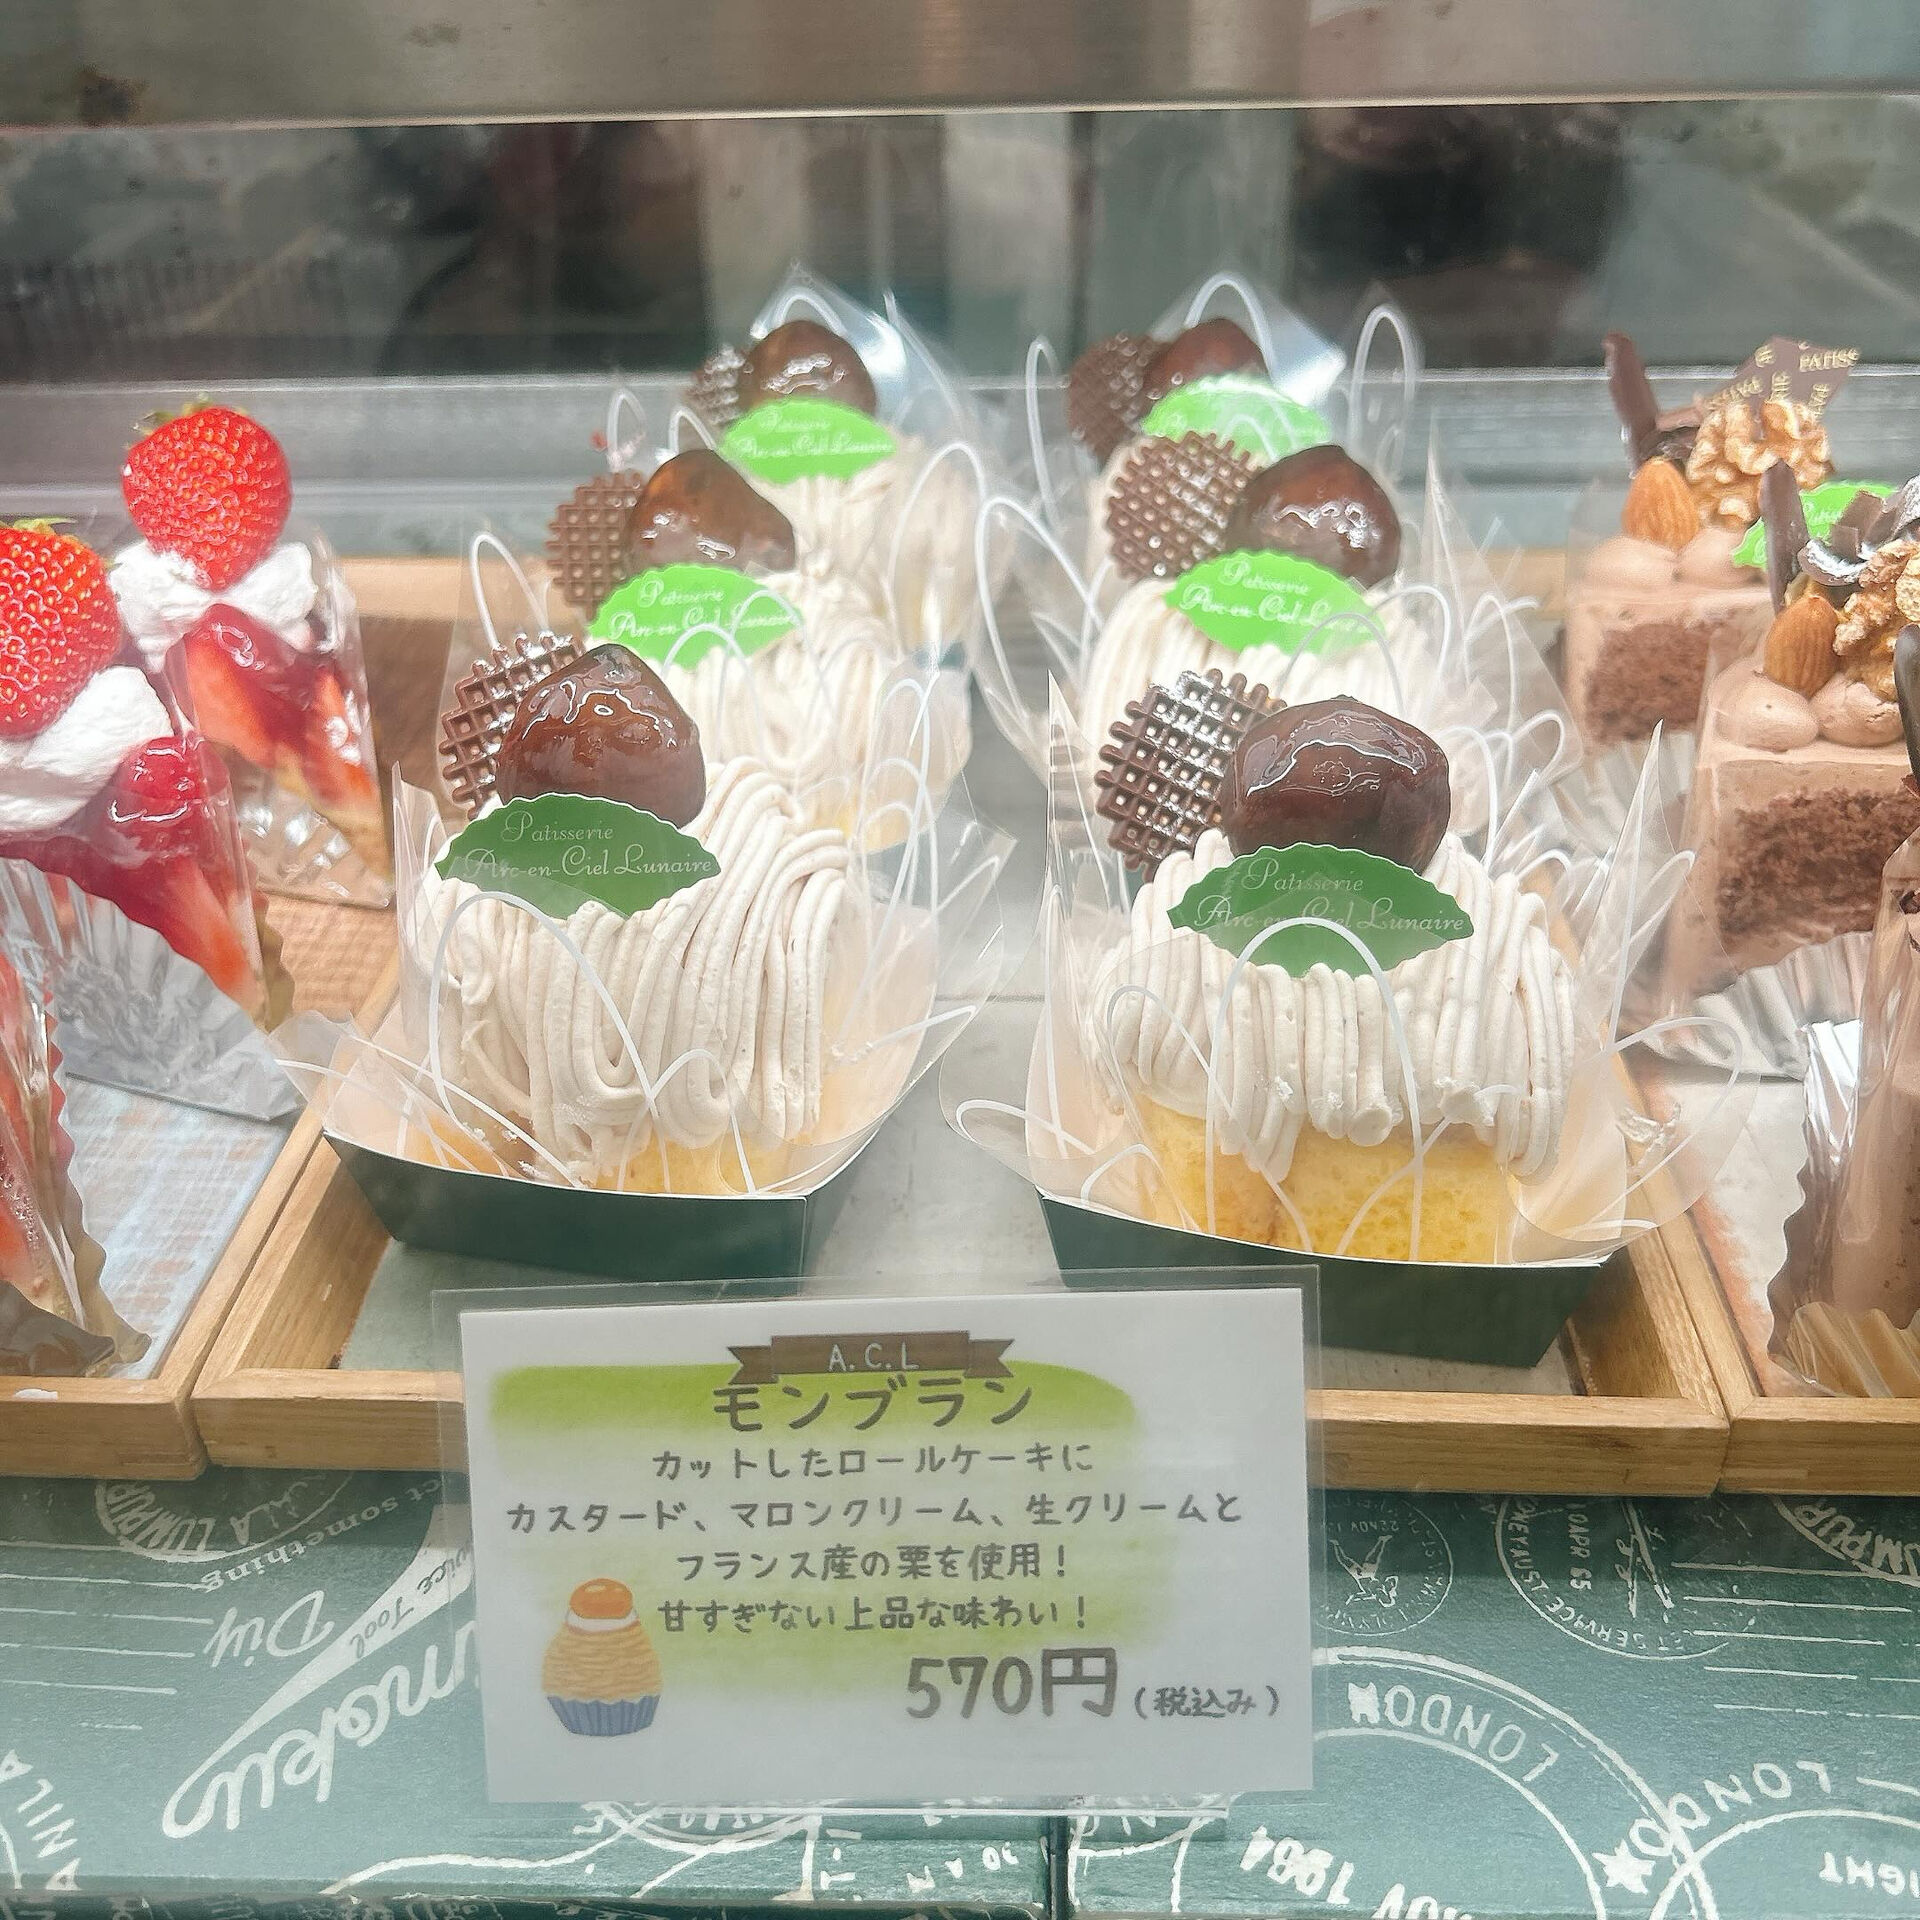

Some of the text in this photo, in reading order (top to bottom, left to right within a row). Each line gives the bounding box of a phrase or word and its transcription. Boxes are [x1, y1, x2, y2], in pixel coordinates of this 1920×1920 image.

[501, 810, 614, 842] Patisserie
[614, 843, 713, 875] Lunaire
[1241, 857, 1364, 892] Patisserie
[1357, 897, 1464, 931] Lunaire
[828, 1342, 920, 1373] A.C.L
[714, 1374, 1035, 1432] モンブラン
[652, 1442, 1095, 1480] カットしたロールケーキに
[506, 1493, 1244, 1534] カスタード、マロンクリーム、生クリームと
[199, 1497, 398, 1593] something
[675, 1542, 1069, 1581] フランス産の栗を使用！
[203, 1590, 335, 1668] Diy
[656, 1595, 1089, 1634] 甘すぎない上品な味わい！
[906, 1646, 1282, 1720] 570円 （税込み）
